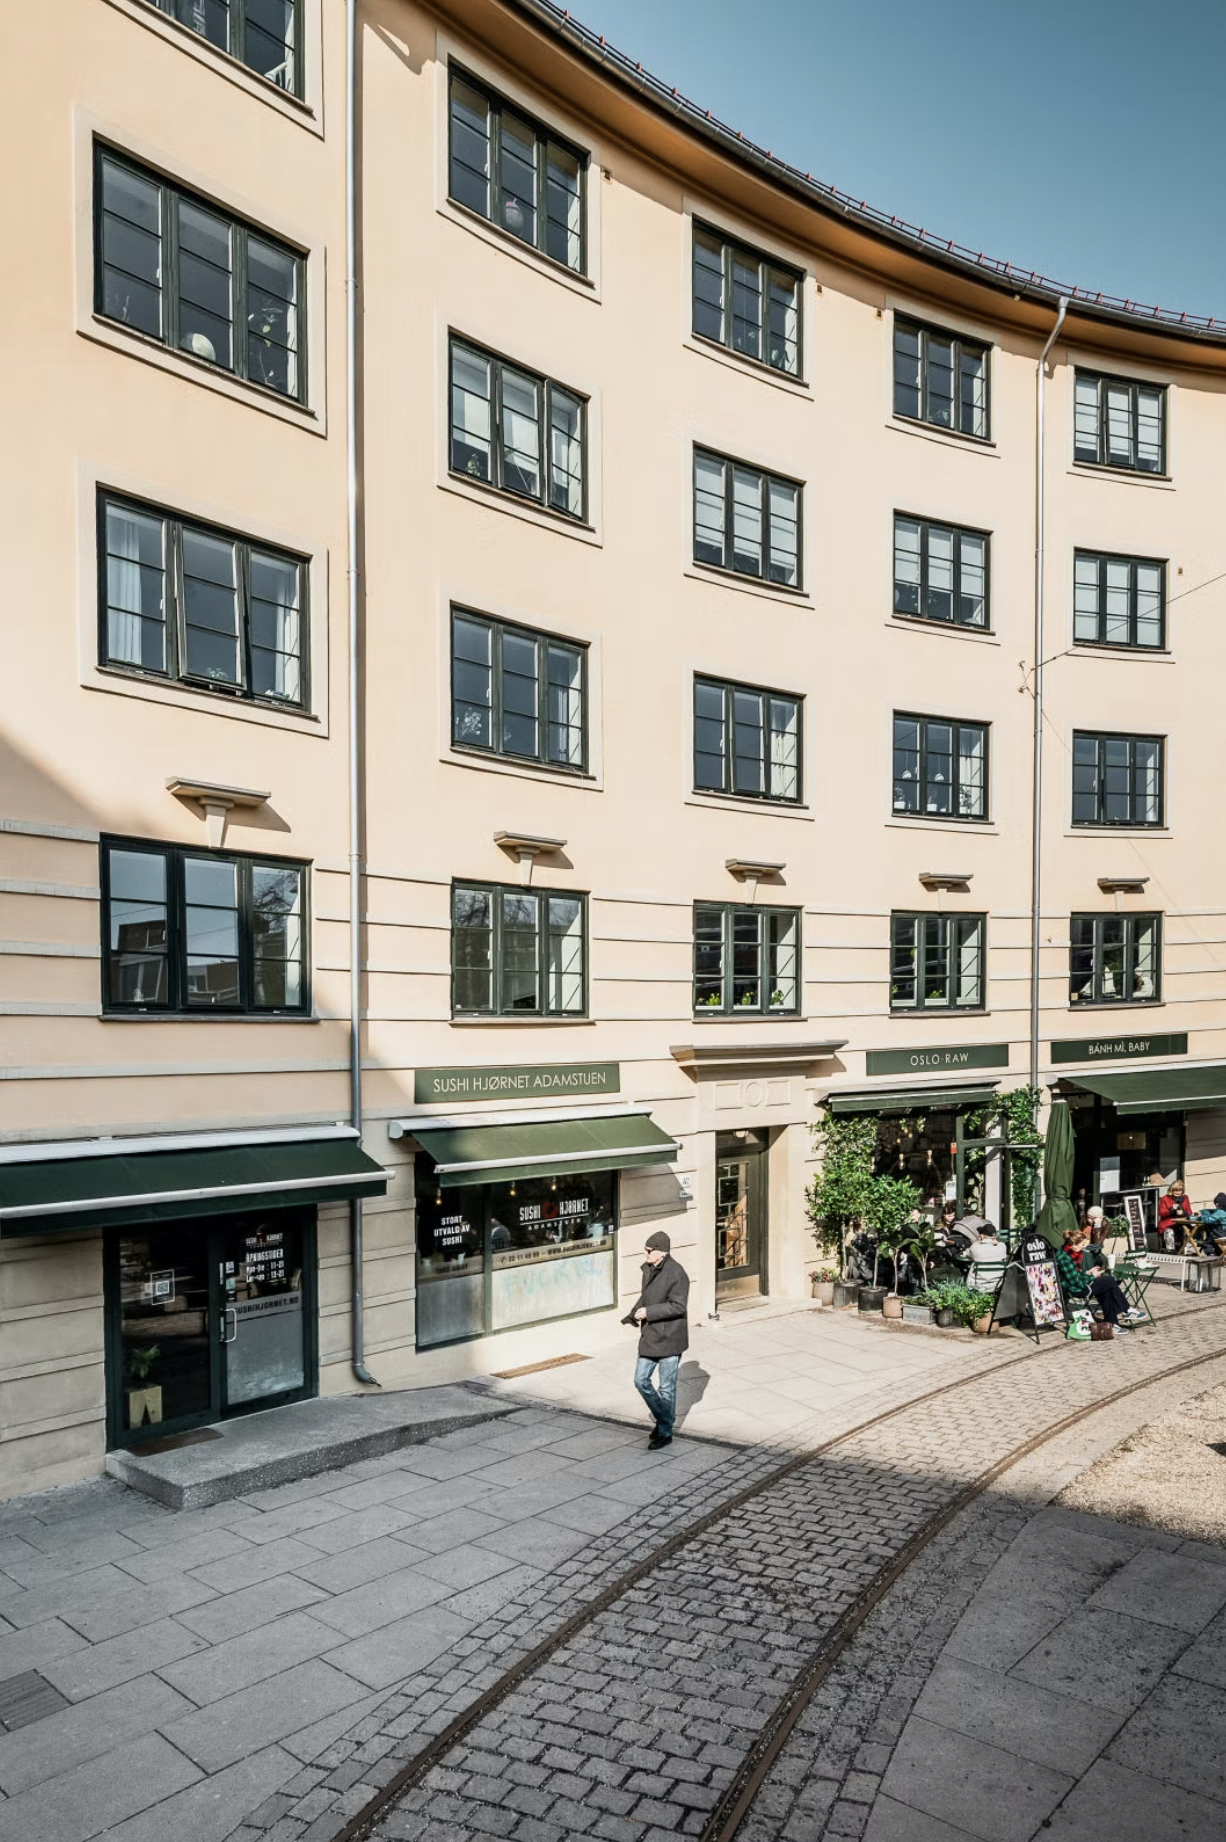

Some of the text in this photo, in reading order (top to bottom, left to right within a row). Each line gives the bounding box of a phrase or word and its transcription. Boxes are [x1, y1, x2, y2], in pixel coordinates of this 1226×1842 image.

[1088, 1042, 1113, 1055] BÁNH
[1128, 1041, 1151, 1052] BABY
[910, 1052, 969, 1066] OSLO RAW
[433, 1071, 606, 1093] SUSHI HJØRNET ADAMSTUEN
[519, 1204, 541, 1221] SUSHI
[441, 1215, 463, 1226] STORT
[460, 1223, 470, 1233] AV
[442, 1235, 462, 1246] SUSHI
[1027, 1238, 1045, 1251] oslo
[1029, 1251, 1046, 1261] raw
